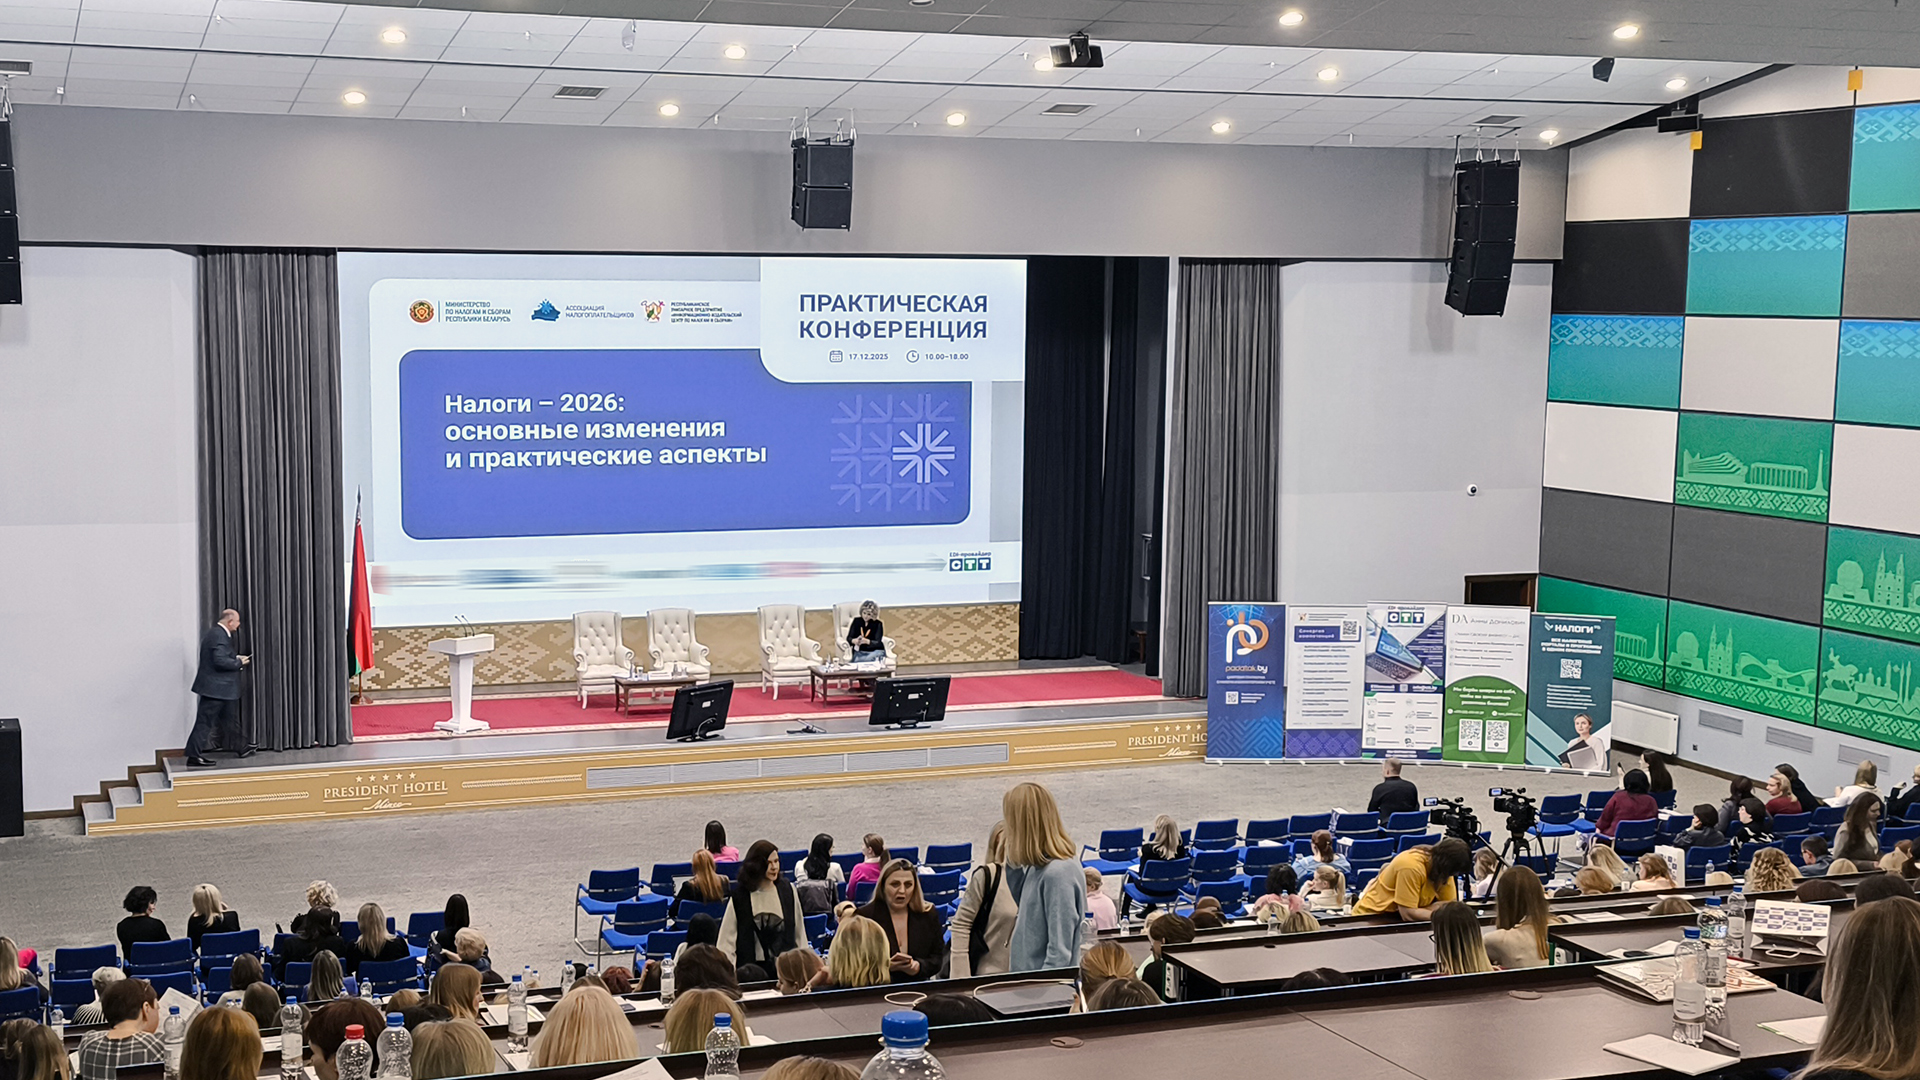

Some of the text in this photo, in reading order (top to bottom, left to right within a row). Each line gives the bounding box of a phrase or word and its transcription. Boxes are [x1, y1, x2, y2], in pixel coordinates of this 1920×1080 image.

[799, 294, 988, 313] ПРАКТИЧЕСКАЯ
[799, 320, 988, 342] КОНФЕРЕНЦИЯ
[445, 395, 531, 413] Налоги
[560, 394, 625, 412] 2026:
[445, 422, 726, 440] основные изменения
[446, 446, 766, 472] и практические аспекты
[1555, 624, 1593, 633] НАЛОГИ
[1128, 734, 1188, 746] PRESIDENT
[324, 781, 448, 798] PRESIDENT HOTEL
